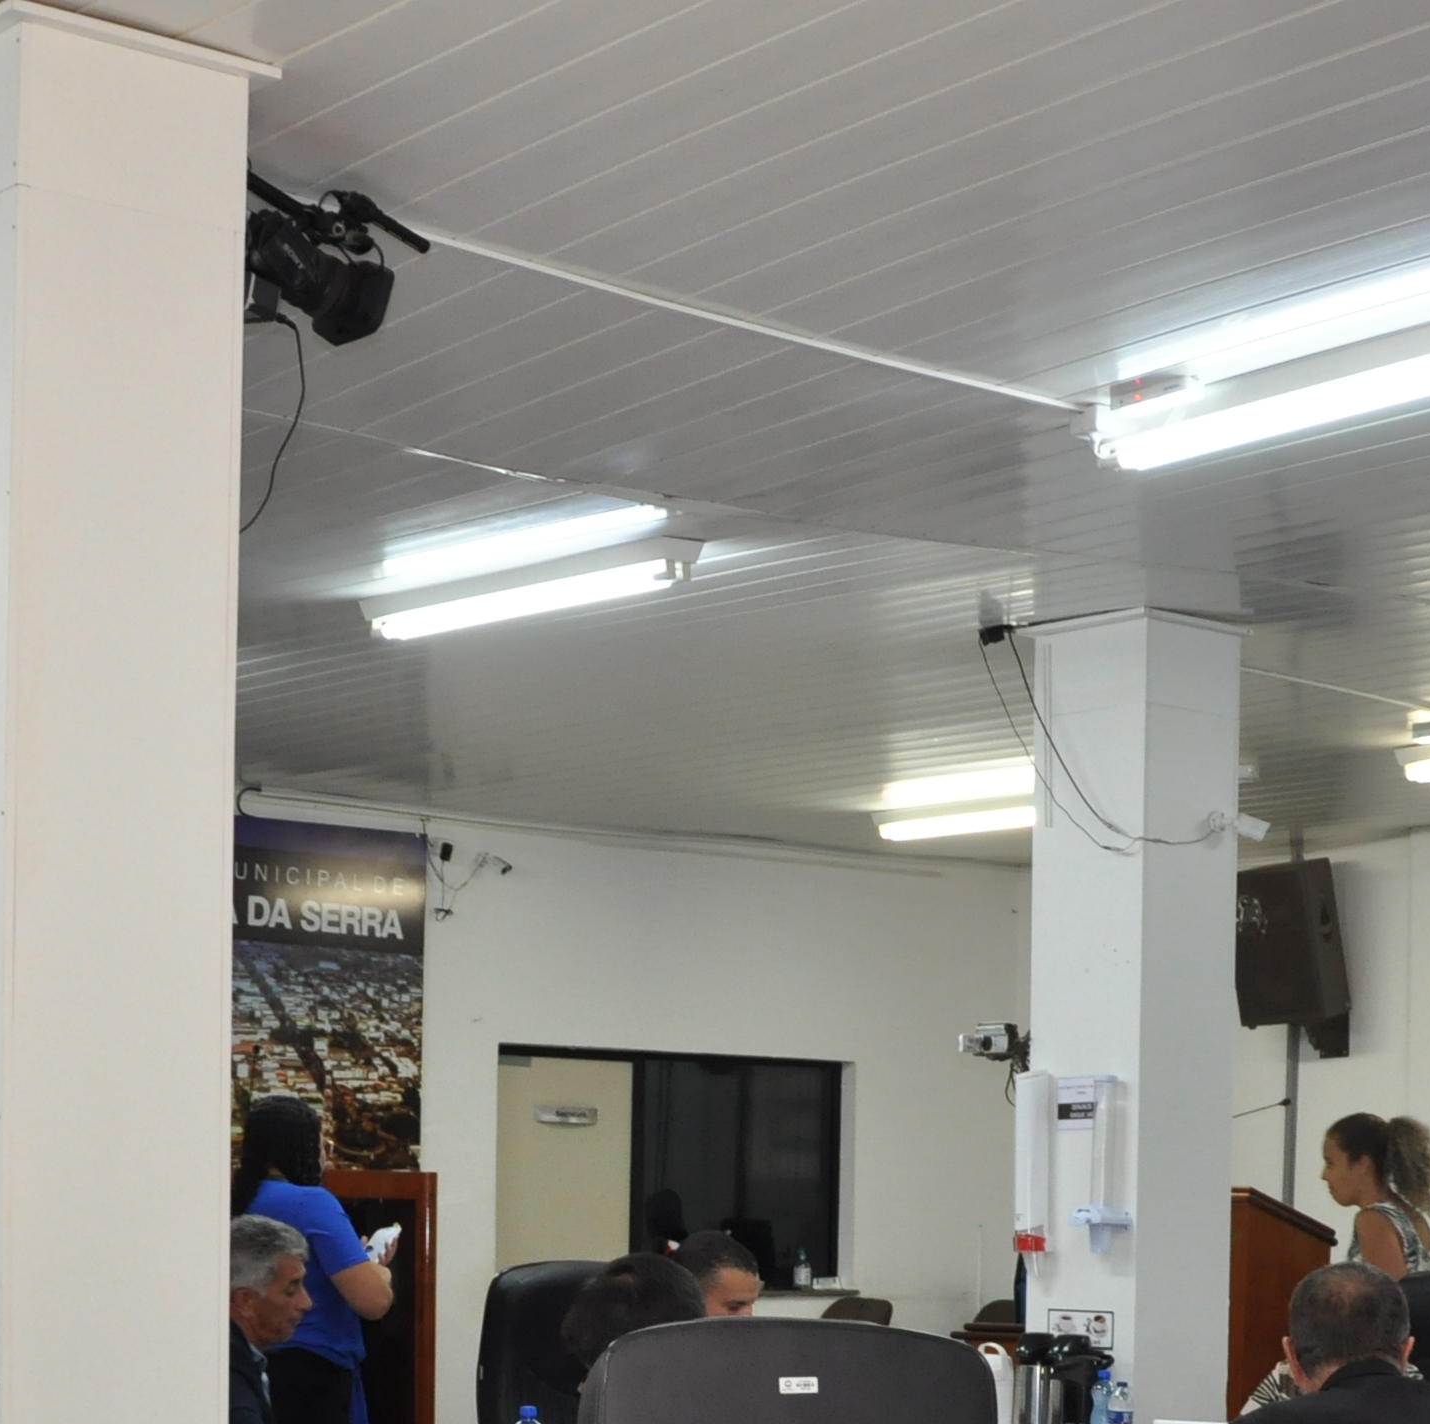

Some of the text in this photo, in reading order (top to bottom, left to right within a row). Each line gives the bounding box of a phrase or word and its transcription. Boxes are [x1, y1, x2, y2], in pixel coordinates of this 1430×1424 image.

[235, 861, 405, 896] UNICIPAL DE
[247, 895, 292, 930] DA
[300, 900, 404, 940] SERRA
